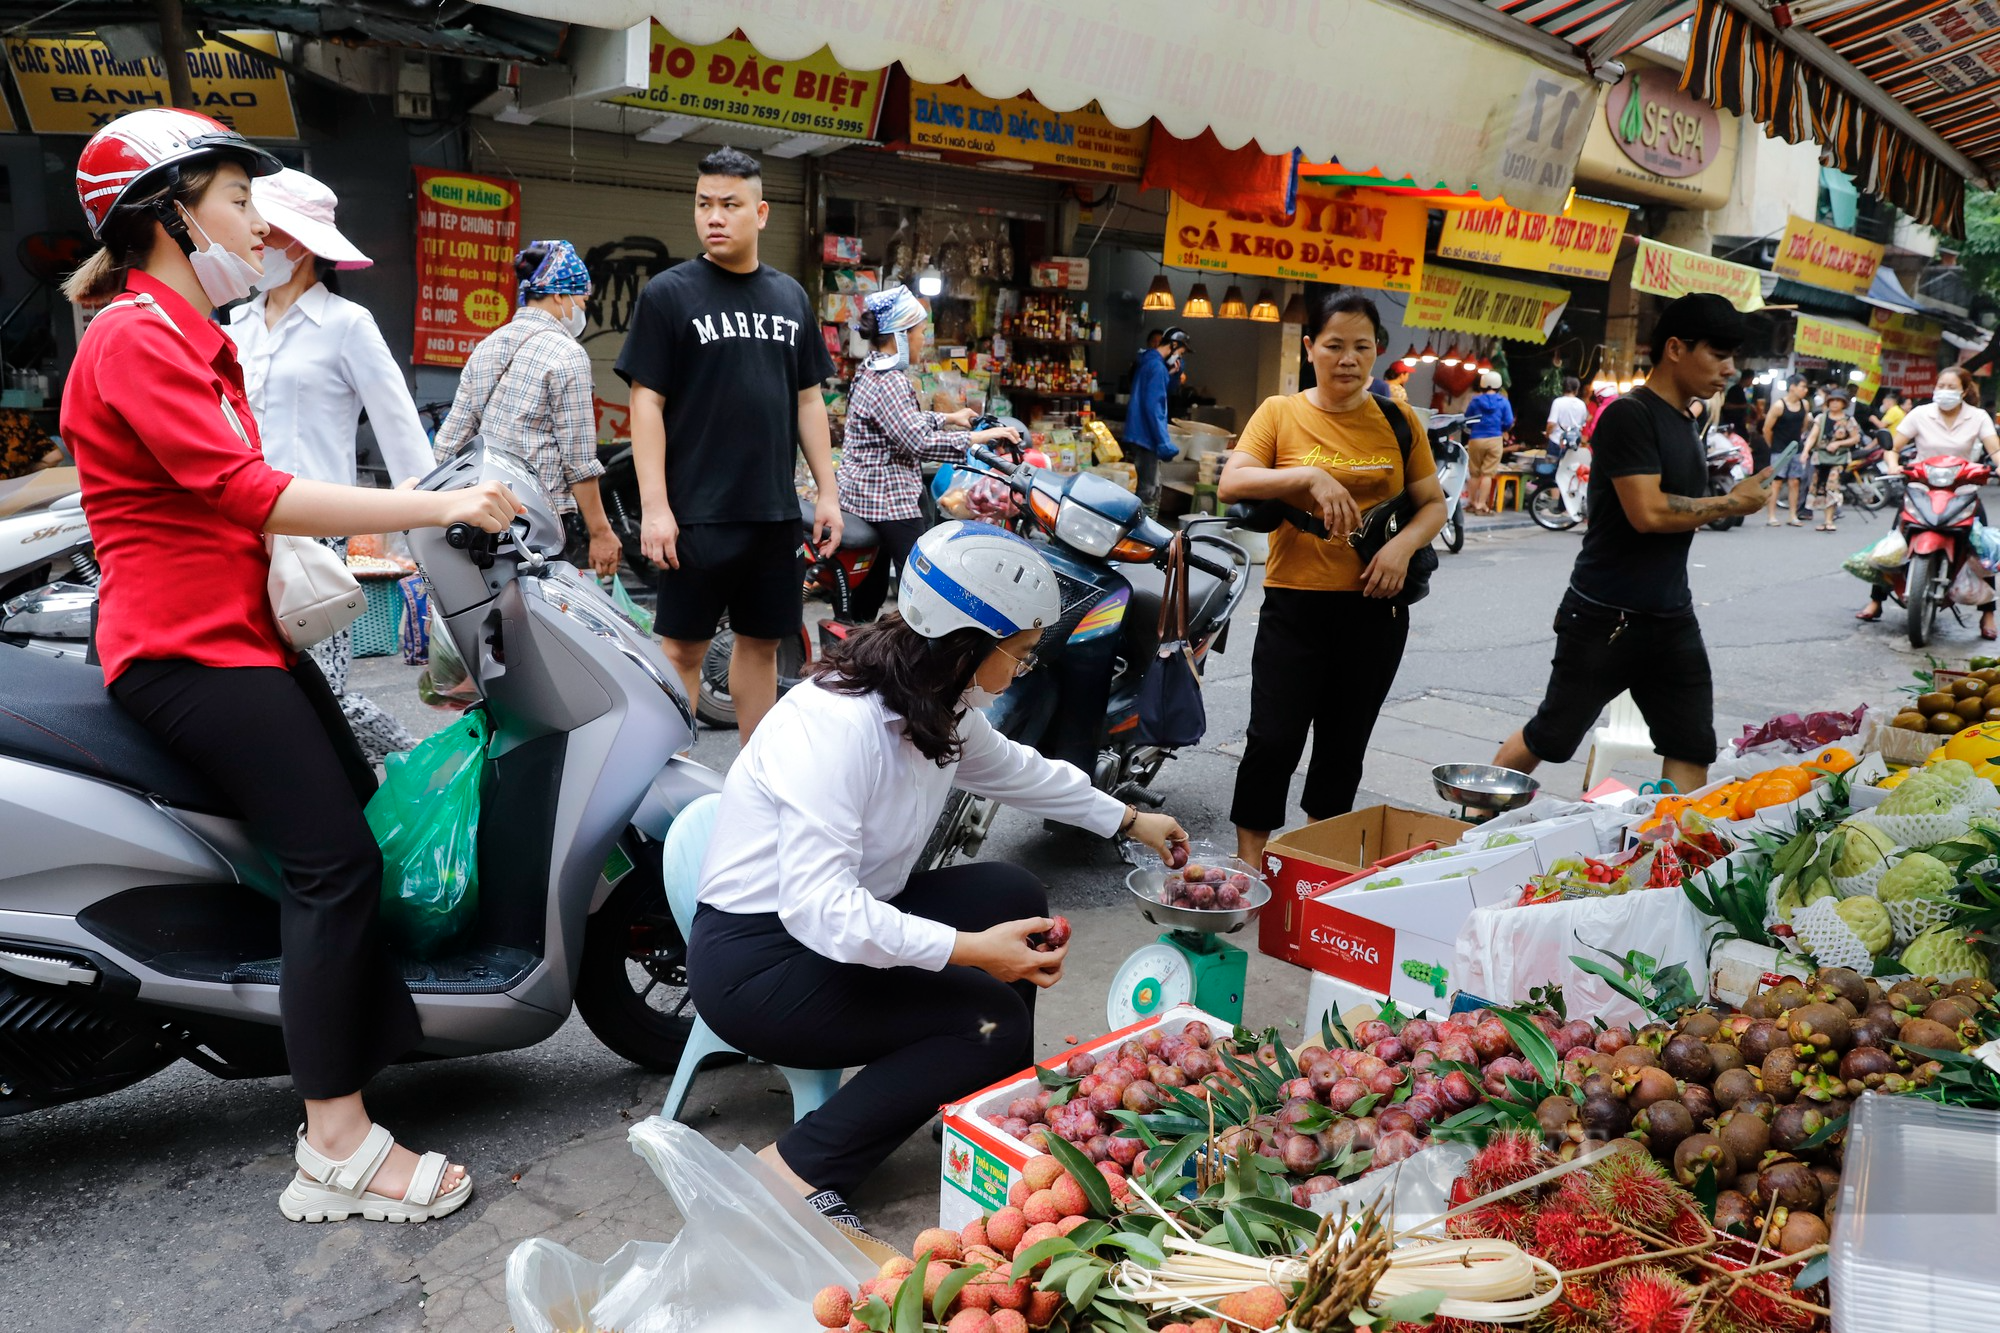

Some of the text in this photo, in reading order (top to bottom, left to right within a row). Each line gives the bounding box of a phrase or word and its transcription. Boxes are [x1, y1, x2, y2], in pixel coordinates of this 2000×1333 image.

[51, 83, 162, 106] BÁNH
[708, 55, 785, 98] ĐẶC
[794, 70, 868, 113] BIỆT
[680, 93, 700, 108] ĐT:
[703, 96, 725, 112] 091
[727, 102, 750, 116] 330
[752, 105, 780, 121] 7699
[792, 111, 813, 125] 091
[814, 114, 834, 129] 655
[835, 117, 864, 133] 9995
[1642, 101, 1671, 150] SF
[1669, 110, 1705, 163] SPA
[432, 184, 463, 204] NGHỊ
[440, 210, 458, 231] TÉP
[1178, 220, 1415, 281] CÁ KHO ĐẶC BIỆT
[692, 310, 800, 347] MARKET
